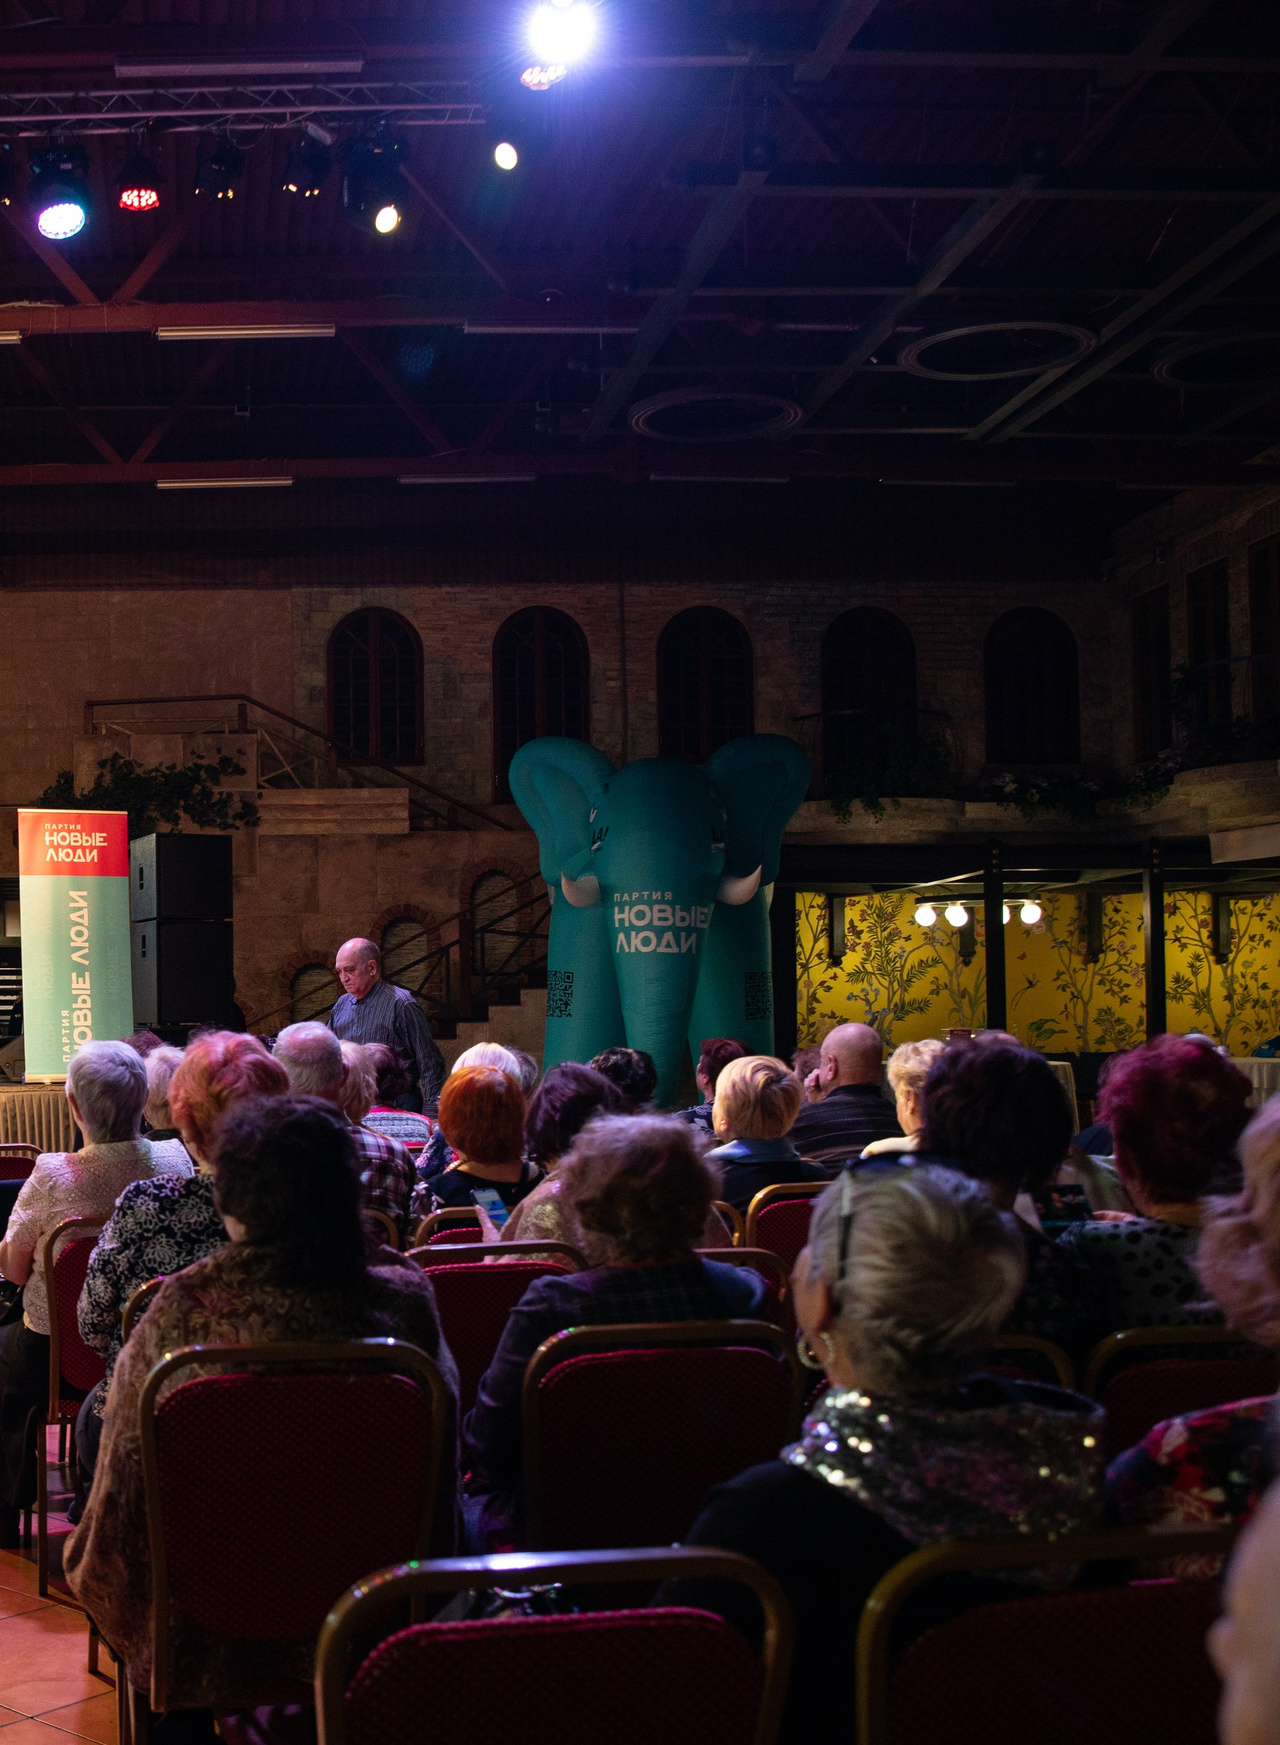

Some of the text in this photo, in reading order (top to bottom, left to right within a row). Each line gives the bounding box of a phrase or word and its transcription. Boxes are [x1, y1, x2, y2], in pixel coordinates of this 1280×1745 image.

[45, 823, 81, 831] ПАРТИЯ
[45, 832, 108, 847] НОВЫЕ
[45, 848, 98, 862] ЛЮДИ
[613, 891, 673, 902] ПАРТИЯ
[614, 904, 709, 928] НОВЫЕ
[615, 930, 698, 954] ЛЮДИ
[69, 890, 93, 1050] ОВЫЕ ЛЮДИ
[61, 1010, 71, 1062] ПАРТИЯ
